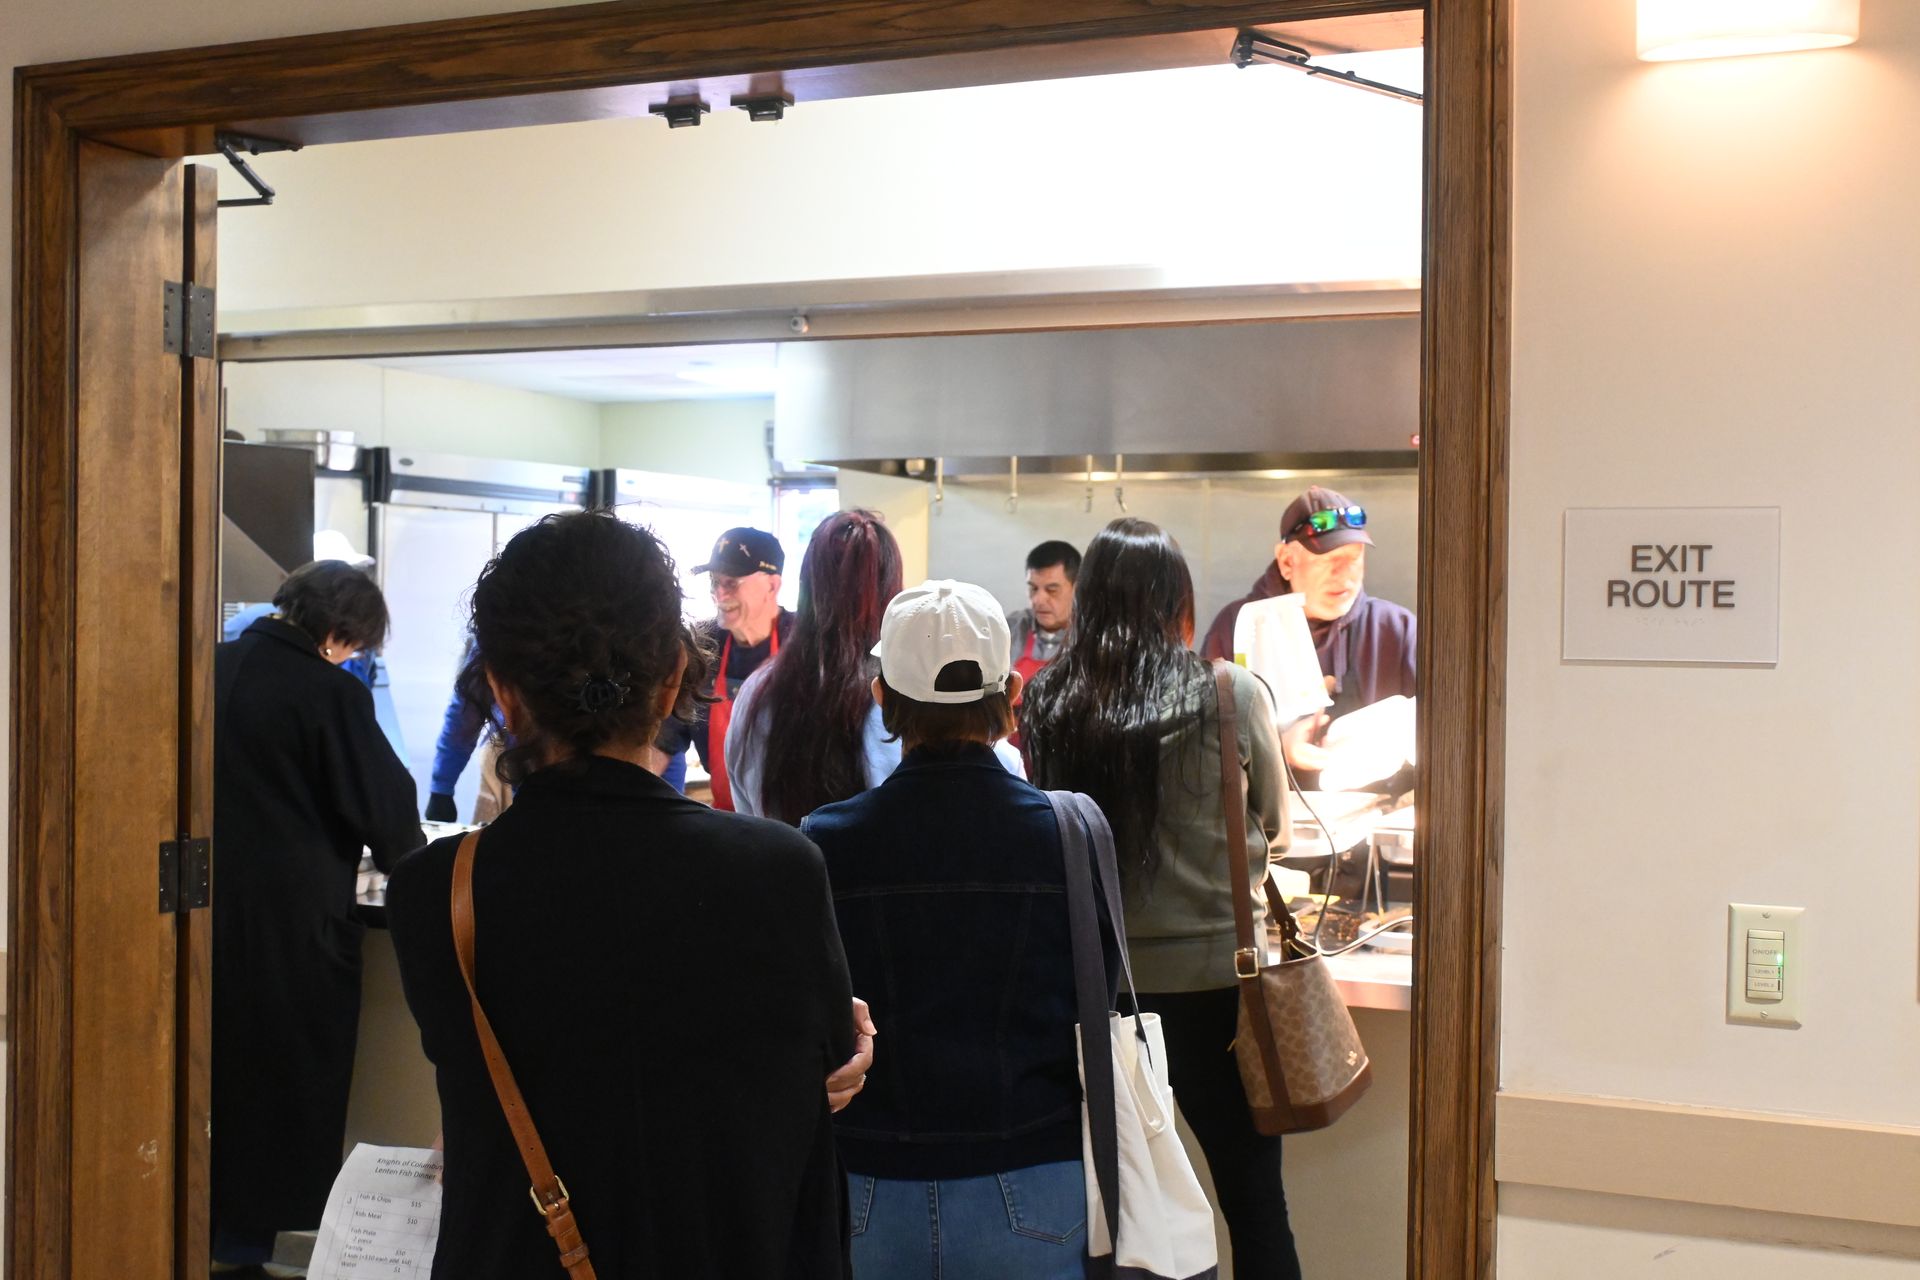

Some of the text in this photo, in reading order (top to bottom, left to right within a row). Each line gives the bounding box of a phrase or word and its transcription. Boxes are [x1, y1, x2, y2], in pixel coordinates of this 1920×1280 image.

[1631, 544, 1713, 573] EXIT
[1607, 579, 1736, 608] ROUTE
[377, 1158, 401, 1167] Knights
[375, 1167, 398, 1176] Lenten
[413, 1171, 436, 1180] Dinner
[376, 1196, 392, 1204] Chips
[355, 1210, 367, 1218] Kids
